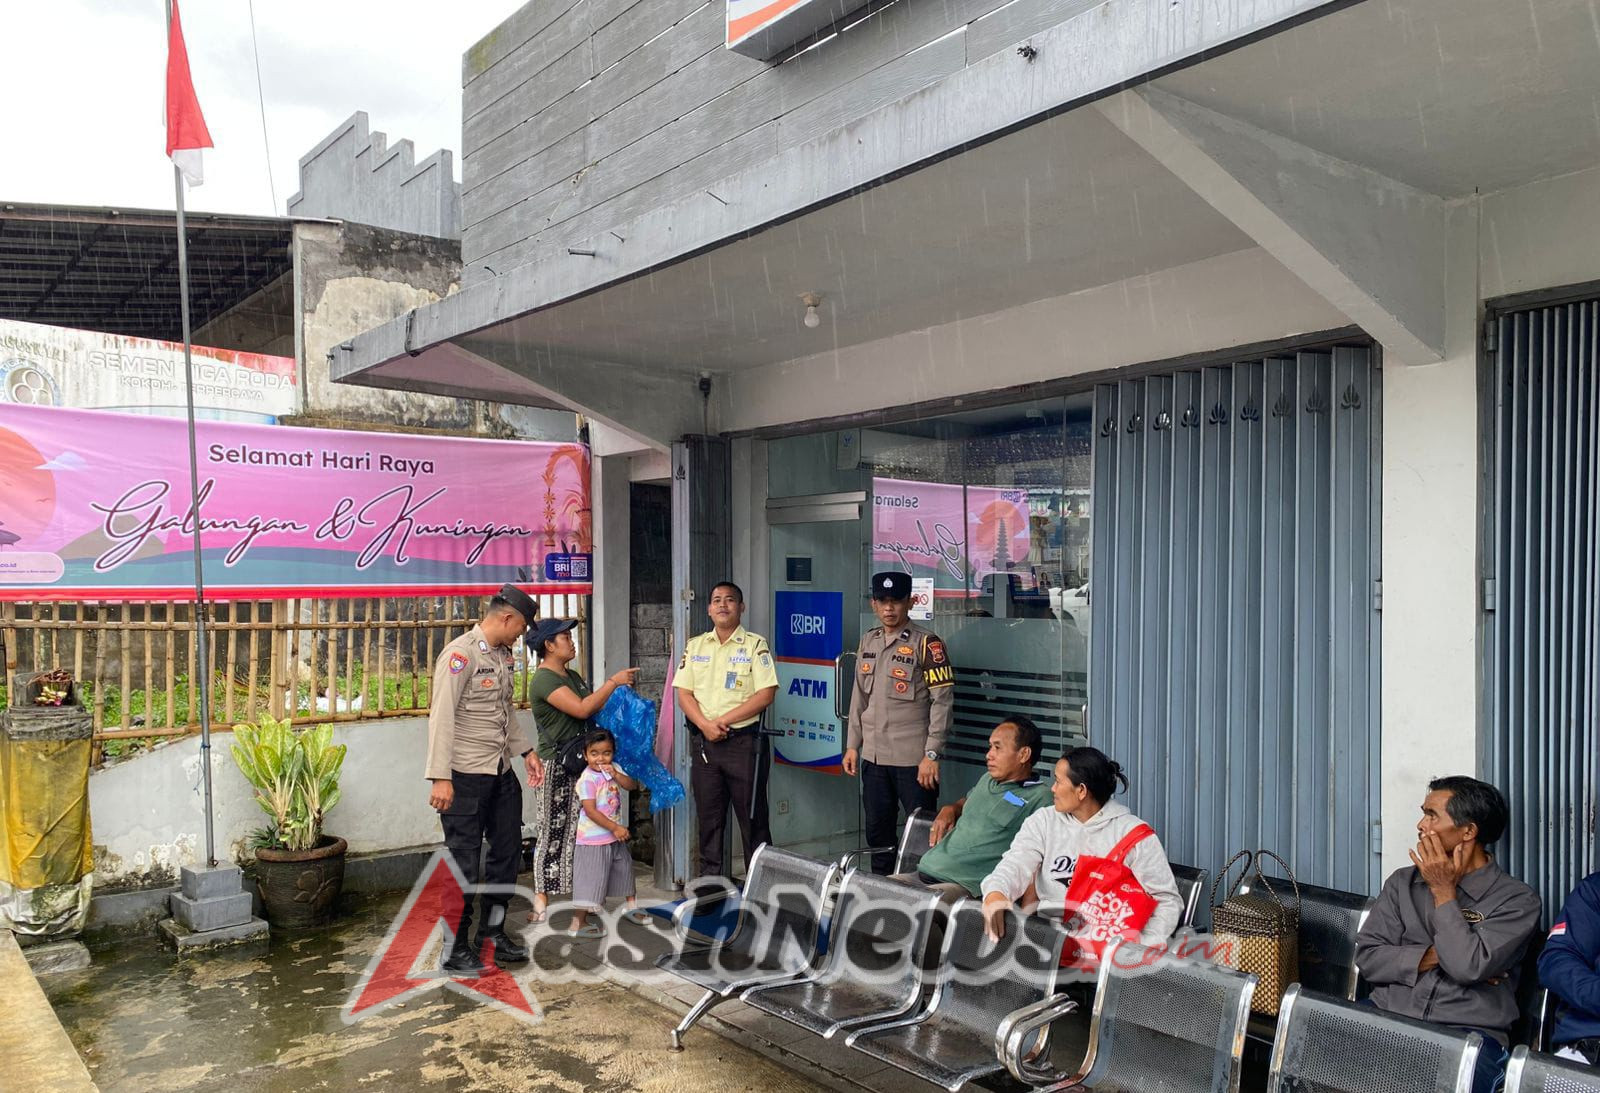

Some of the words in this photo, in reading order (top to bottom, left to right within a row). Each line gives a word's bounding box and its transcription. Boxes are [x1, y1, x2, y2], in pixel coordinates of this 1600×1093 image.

[88, 351, 175, 377] SEMEN
[234, 369, 294, 391] RODA
[209, 444, 314, 467] Selamat
[322, 452, 371, 470] Hari
[379, 455, 435, 477] Raya
[91, 479, 308, 572] Galungan
[315, 497, 355, 541] &
[356, 484, 532, 572] Kuningan
[554, 563, 570, 572] BRI
[804, 615, 826, 635] BRI
[891, 654, 915, 665] POLRI
[788, 678, 828, 699] ATM
[1050, 855, 1077, 873] Di
